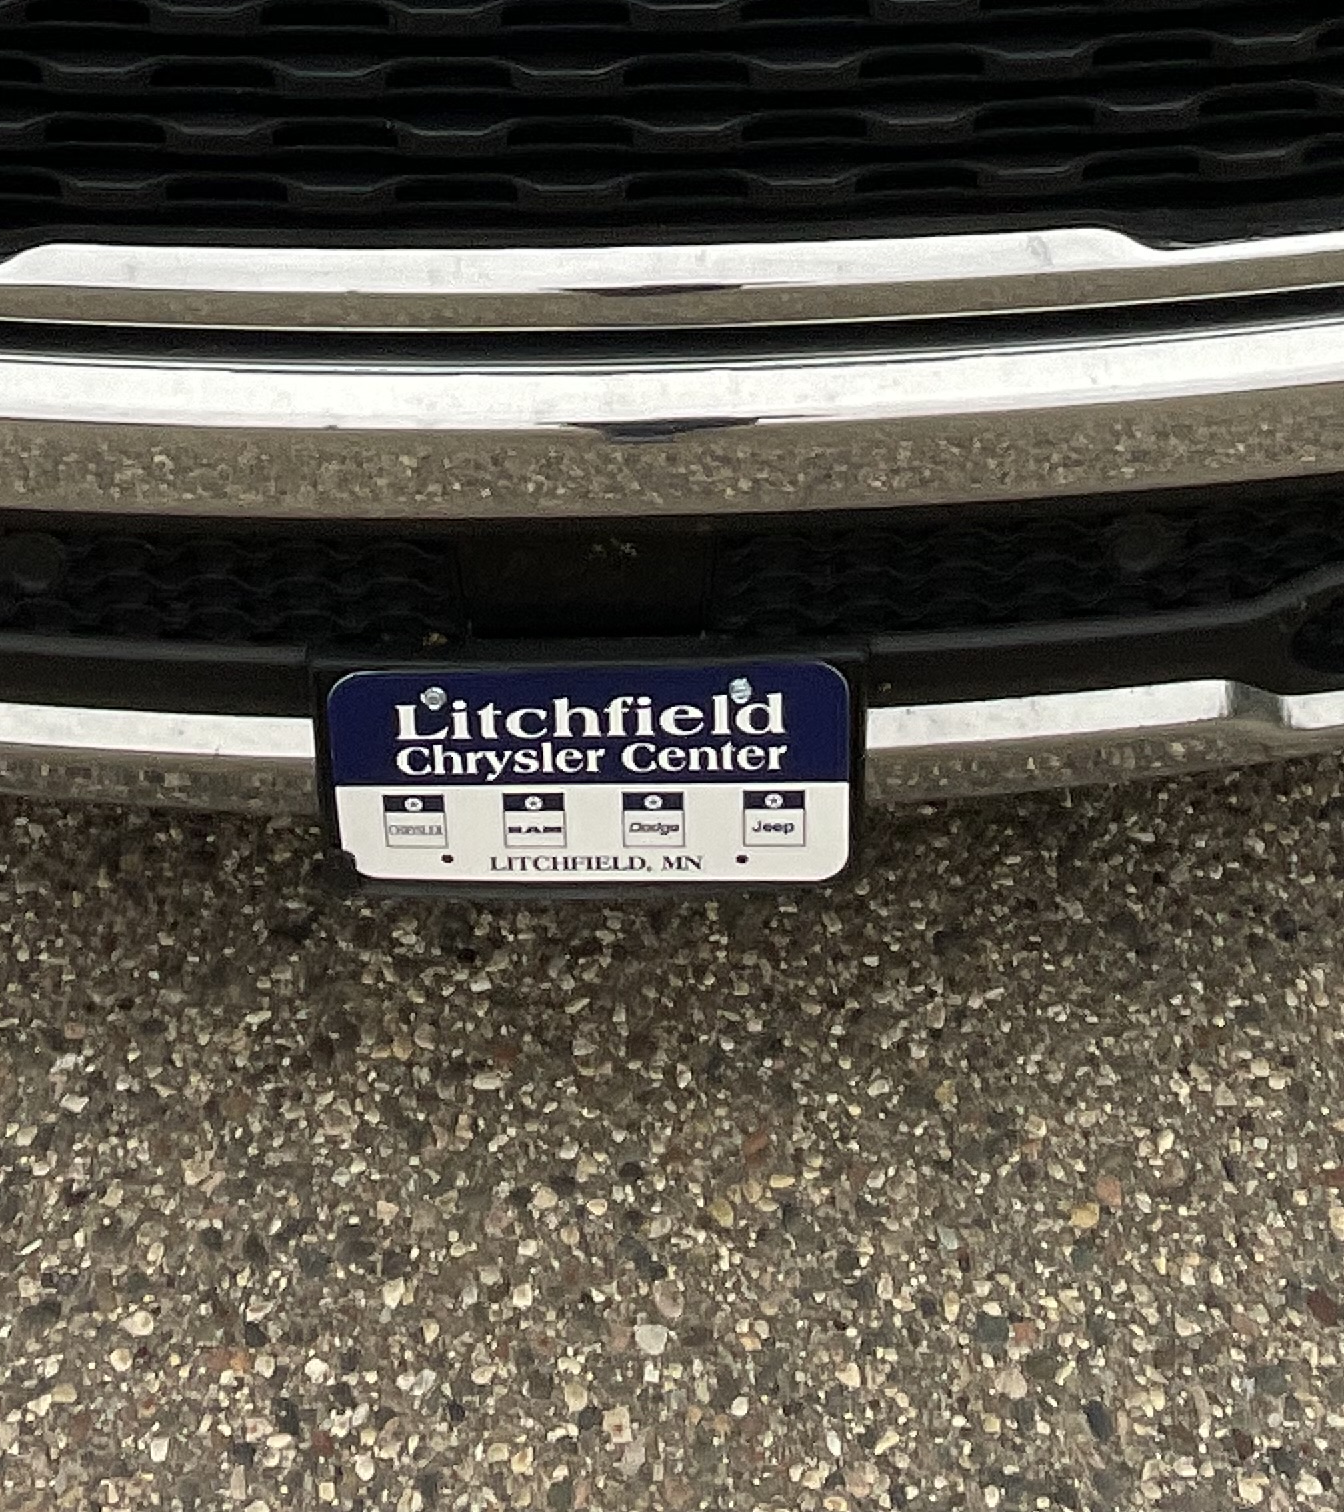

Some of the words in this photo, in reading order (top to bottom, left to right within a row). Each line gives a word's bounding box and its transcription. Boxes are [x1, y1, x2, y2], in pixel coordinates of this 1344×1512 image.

[395, 692, 787, 740] Litchfield
[396, 742, 605, 781] Chrysler
[621, 740, 787, 772] Center
[629, 822, 680, 835] Dodge
[752, 820, 795, 835] Jeep
[490, 855, 652, 872] LITCHFIELD,
[661, 855, 703, 871] MN
